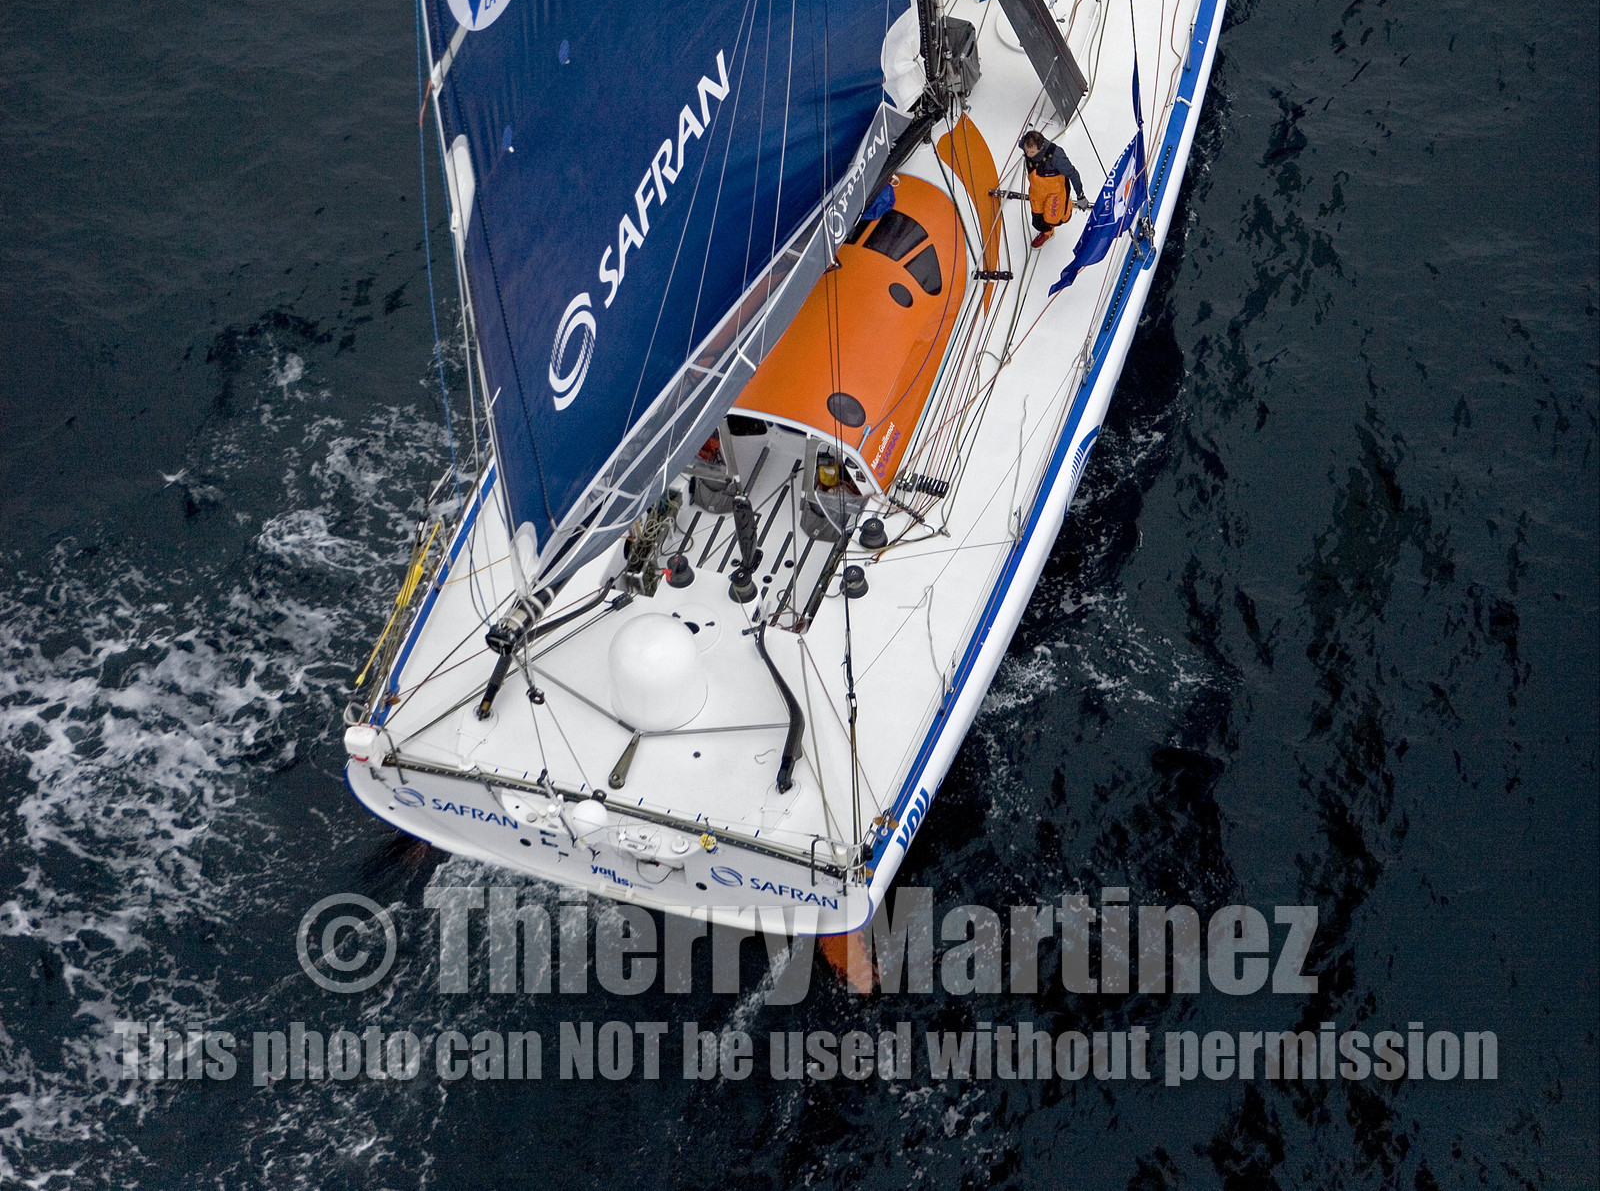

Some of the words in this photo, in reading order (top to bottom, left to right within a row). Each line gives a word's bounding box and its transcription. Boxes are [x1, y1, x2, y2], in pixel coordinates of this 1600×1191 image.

[599, 49, 730, 309] SAFRAN
[870, 451, 881, 470] Marc
[432, 798, 519, 830] SAFRAN
[750, 877, 838, 910] SAFRAN
